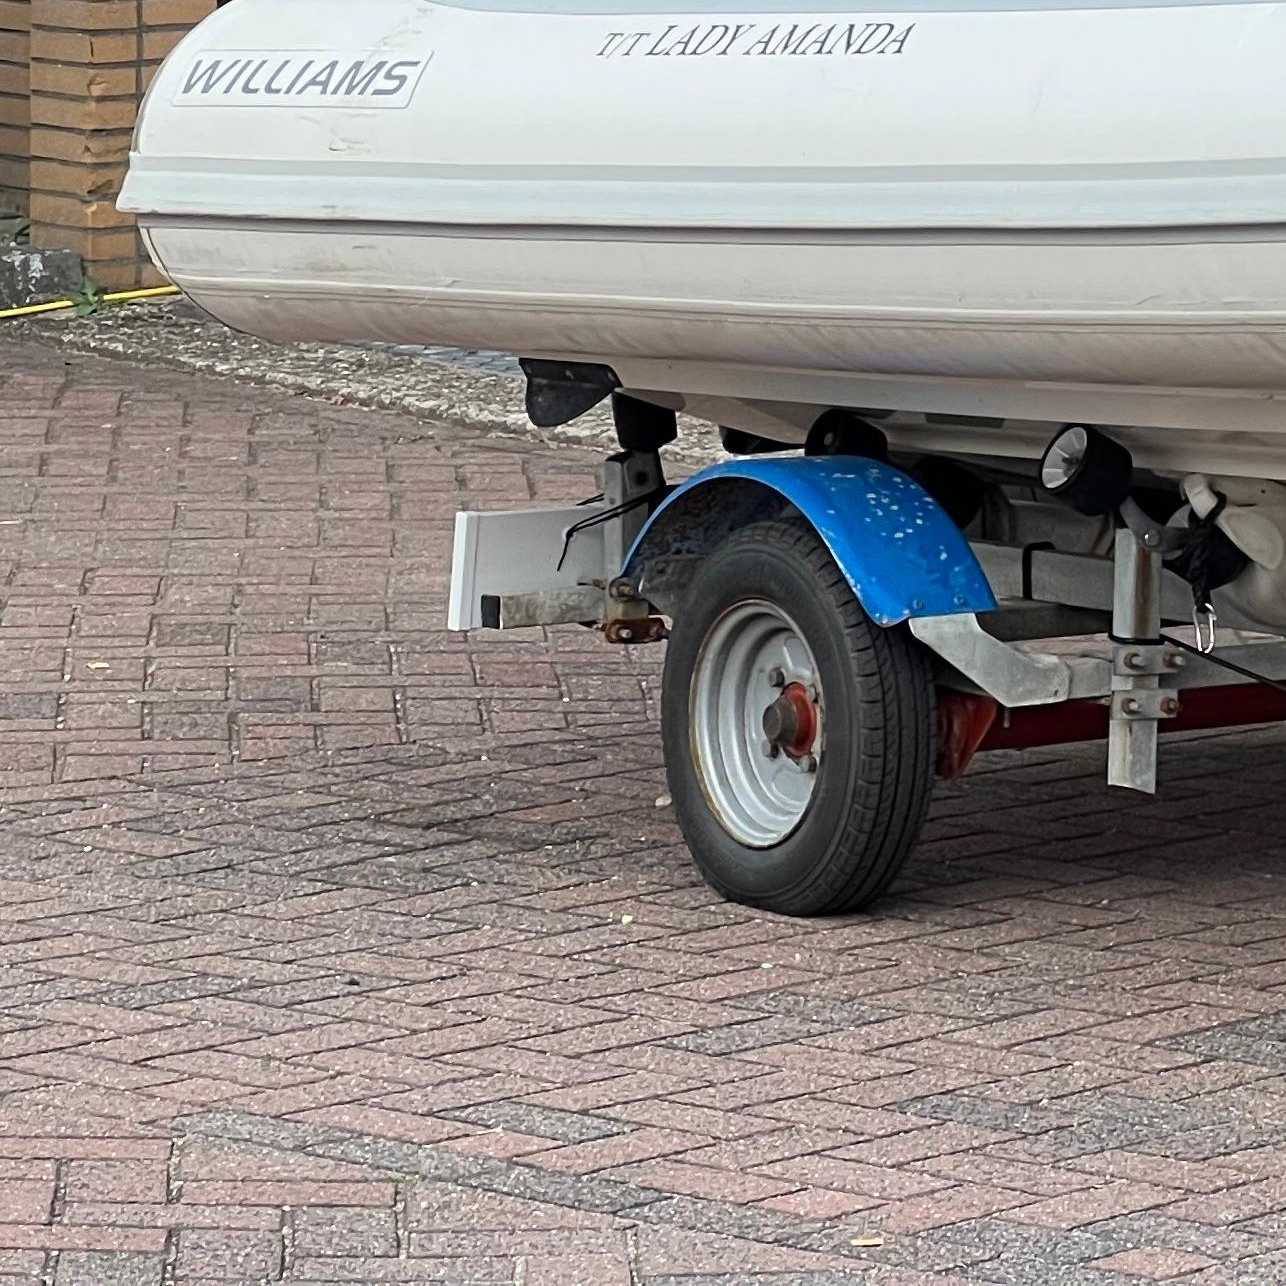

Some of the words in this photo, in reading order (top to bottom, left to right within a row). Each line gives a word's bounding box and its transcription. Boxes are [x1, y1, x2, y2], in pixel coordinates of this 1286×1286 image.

[645, 24, 756, 56] LADY
[743, 23, 917, 56] AMANDA
[182, 59, 421, 96] WILLIAMS
